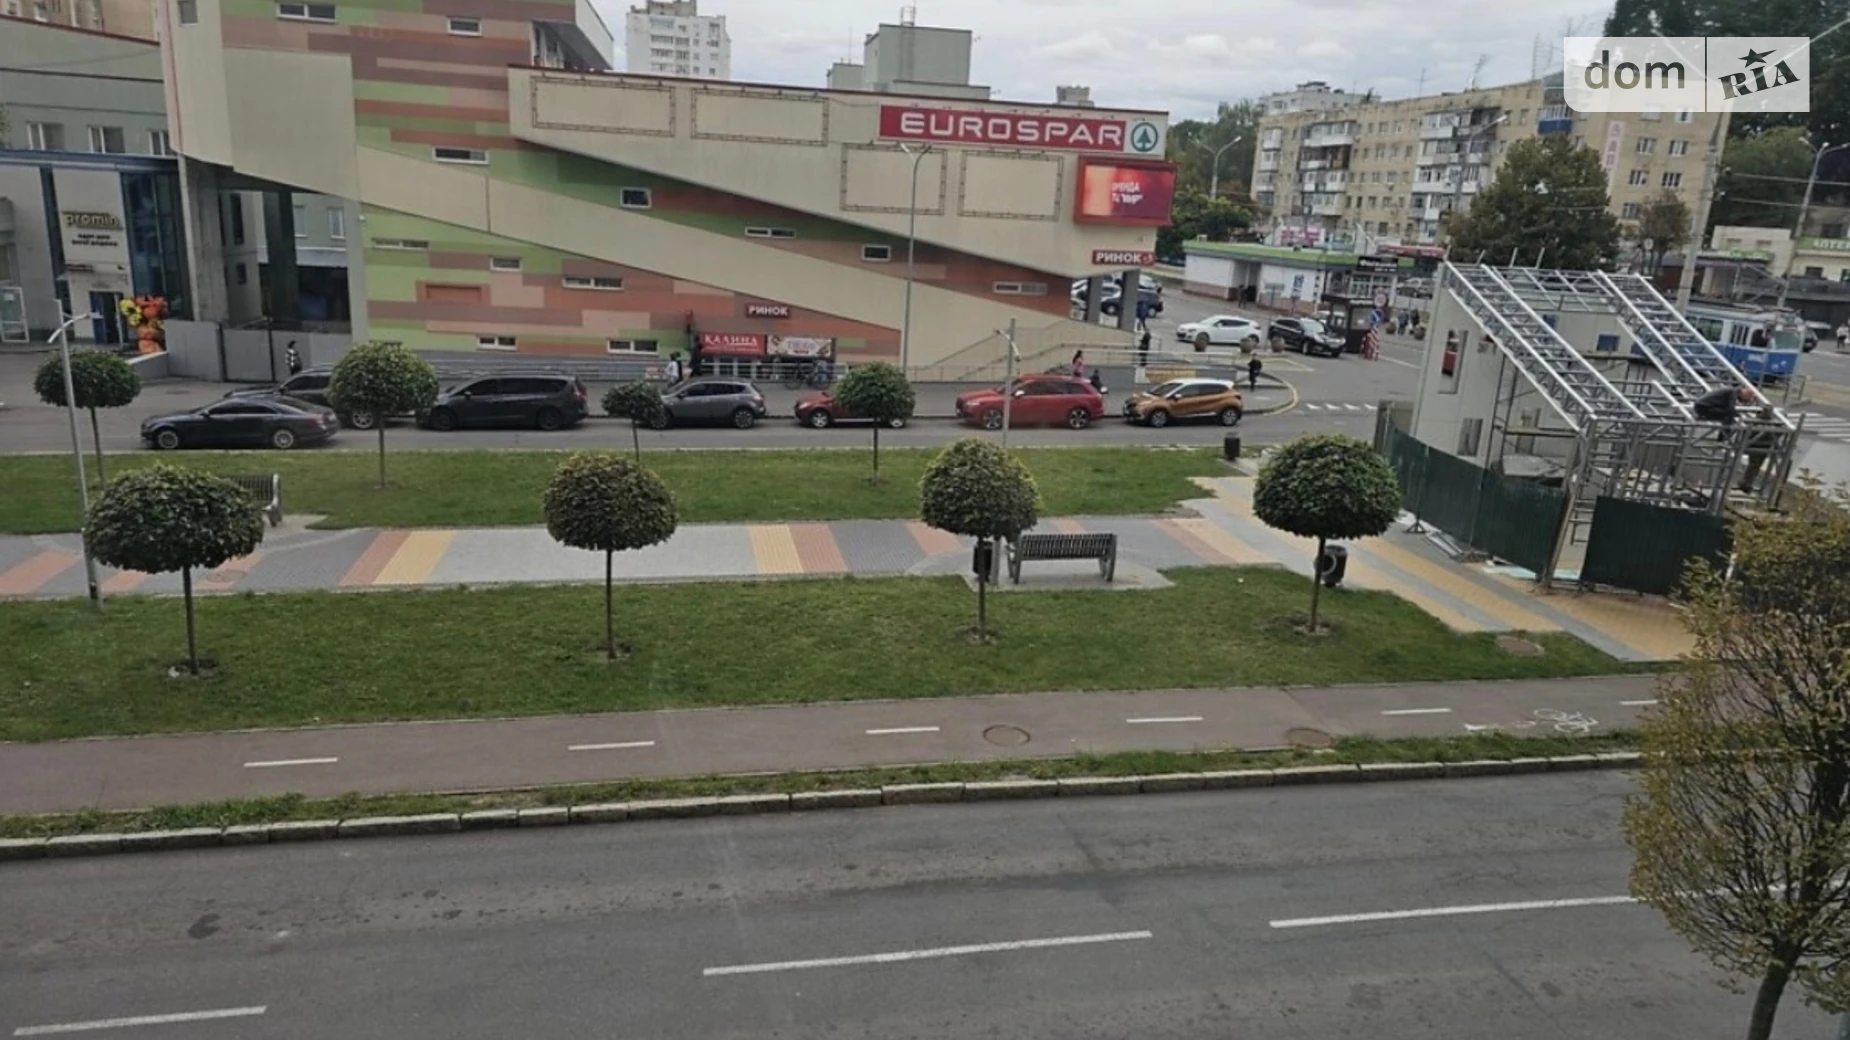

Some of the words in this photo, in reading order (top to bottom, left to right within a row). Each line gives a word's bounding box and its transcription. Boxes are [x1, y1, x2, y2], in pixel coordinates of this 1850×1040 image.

[900, 111, 1122, 146] EUROSPAR
[1096, 252, 1141, 264] РИНОК
[748, 305, 788, 316] РИНОК
